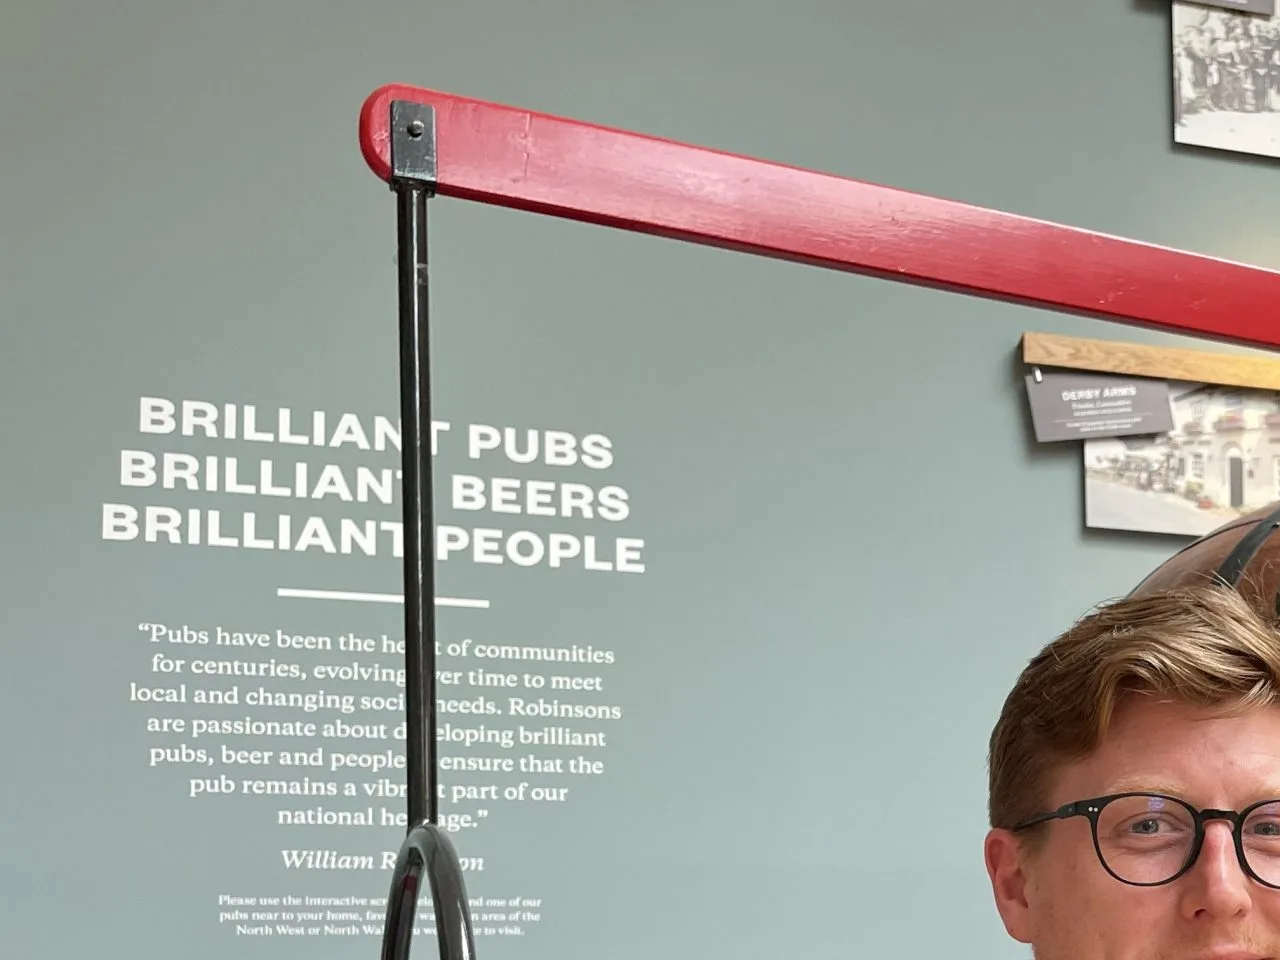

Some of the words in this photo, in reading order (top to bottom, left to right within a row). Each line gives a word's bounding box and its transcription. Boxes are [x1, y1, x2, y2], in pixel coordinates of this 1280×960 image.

[139, 396, 451, 456] BRILLIANT
[468, 423, 614, 470] PUBS
[120, 449, 403, 504] BRILLIAN
[451, 473, 630, 522] BEERS
[101, 503, 404, 558] BRILLIANT
[436, 525, 646, 573] PEOPLE
[138, 623, 209, 645] “Pubs
[216, 627, 271, 647] have
[276, 629, 332, 651] been
[338, 633, 376, 653] the
[382, 635, 441, 656] het
[447, 639, 473, 657] of
[474, 643, 615, 665] communities
[152, 653, 186, 673] for
[190, 659, 307, 681] centuries,
[313, 662, 406, 688] evolving
[468, 669, 518, 688] time
[523, 673, 545, 689] to
[551, 675, 604, 691] meet
[130, 682, 186, 703] local
[193, 686, 239, 705] and
[245, 687, 355, 713] changing
[360, 693, 404, 712] soci
[436, 696, 502, 715] needs.
[508, 698, 622, 720] Robinsons
[147, 717, 186, 733] are
[192, 716, 317, 738] passionate
[322, 719, 388, 739] about
[393, 721, 514, 748] deloping
[519, 725, 607, 747] brilliant
[149, 744, 214, 766] pubs,
[221, 745, 273, 765] beer
[278, 748, 324, 767] and
[330, 750, 406, 772] people
[439, 756, 514, 773] ensure
[519, 754, 564, 774] that
[568, 756, 604, 775] the
[189, 774, 236, 798] pub
[241, 777, 338, 797] remains
[343, 782, 357, 797] a
[363, 779, 446, 798] vibrt
[452, 783, 499, 803] part
[504, 782, 528, 801] of
[531, 787, 569, 801] our
[277, 806, 374, 826] national
[381, 807, 488, 832] heage.”
[281, 849, 374, 870] William
[218, 894, 257, 906] Please
[259, 896, 280, 906] use
[282, 894, 302, 906] the
[305, 895, 368, 907] interactive
[486, 898, 506, 908] one
[508, 896, 522, 908] of
[522, 898, 542, 908] our
[219, 909, 249, 923] pubs
[251, 912, 279, 921] near
[282, 910, 295, 921] to
[296, 912, 323, 923] your
[326, 910, 363, 922] home,
[481, 912, 507, 922] area
[508, 911, 521, 922] of
[522, 911, 541, 922] the
[236, 924, 273, 936] North
[275, 924, 305, 936] West
[307, 927, 320, 936] or
[324, 924, 360, 936] North
[362, 925, 385, 936] Wal
[483, 926, 496, 936] to
[497, 925, 525, 936] visit.
